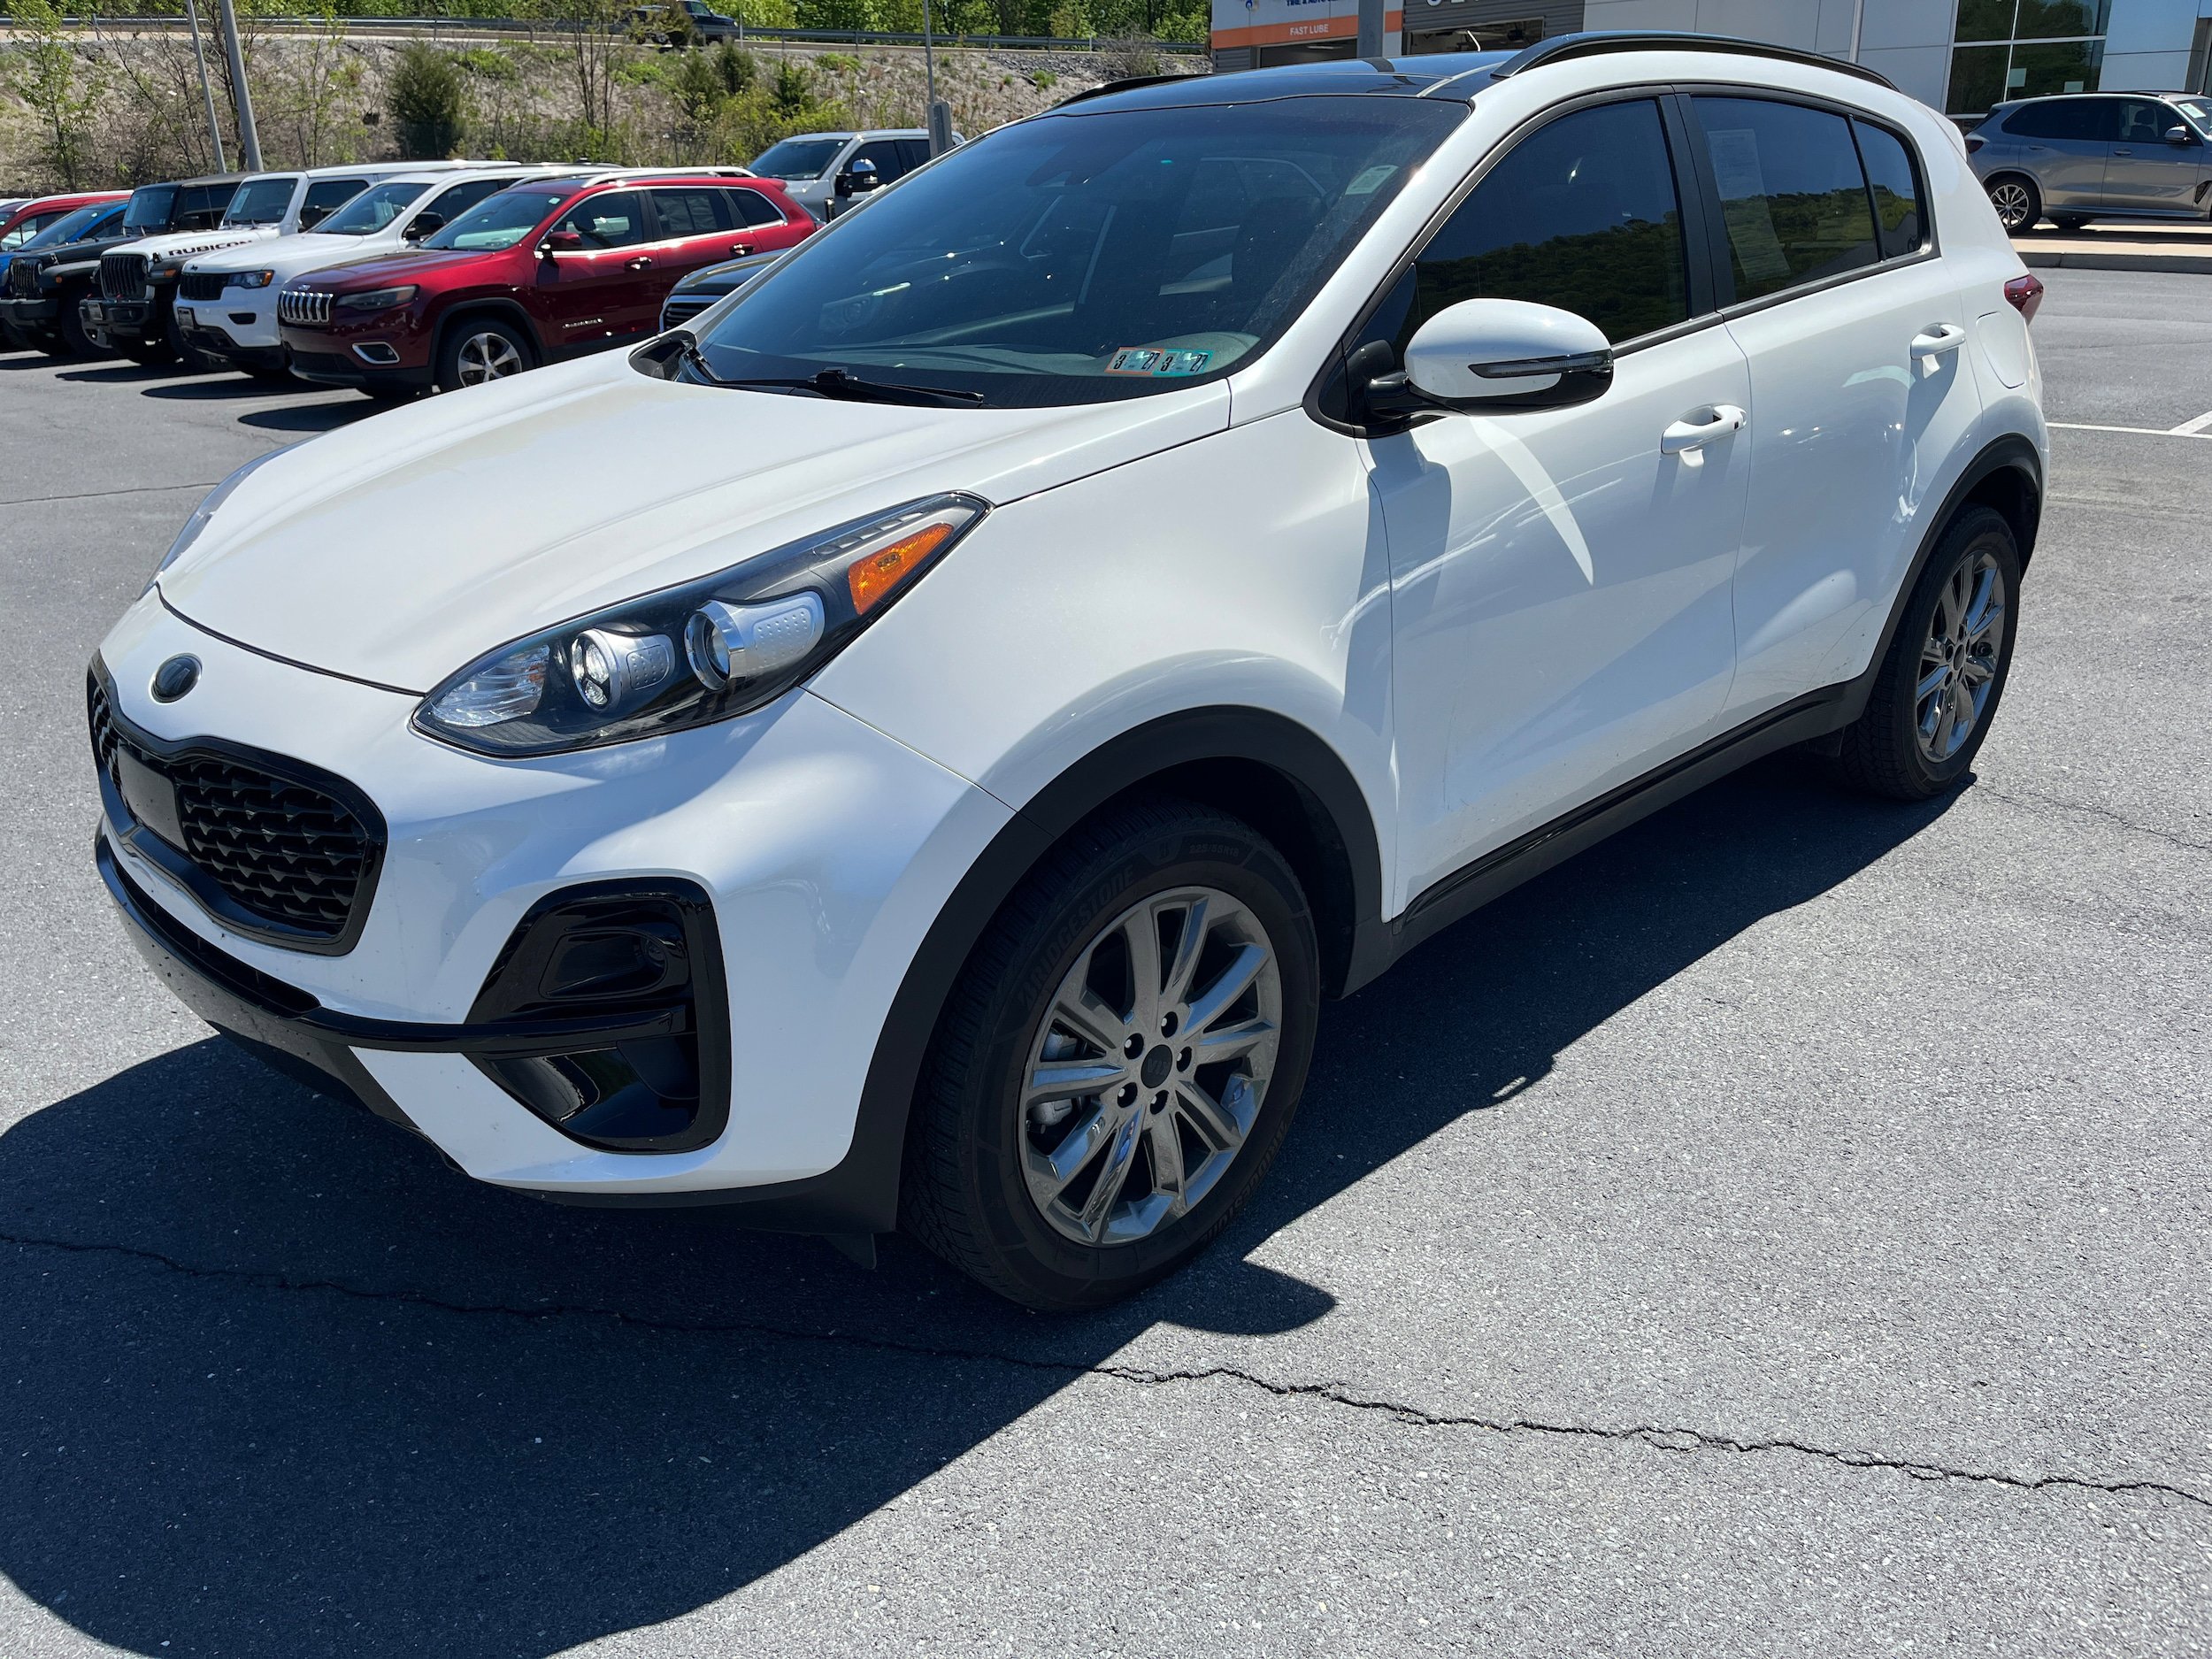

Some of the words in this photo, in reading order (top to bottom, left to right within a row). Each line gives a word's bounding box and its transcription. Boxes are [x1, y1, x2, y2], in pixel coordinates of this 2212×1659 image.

[1290, 26, 1308, 35] FAST
[1310, 24, 1329, 35] LUBE
[1113, 354, 1127, 370] 3
[1160, 356, 1174, 372] 3
[1018, 864, 1133, 1007] BRIDGESTONE
